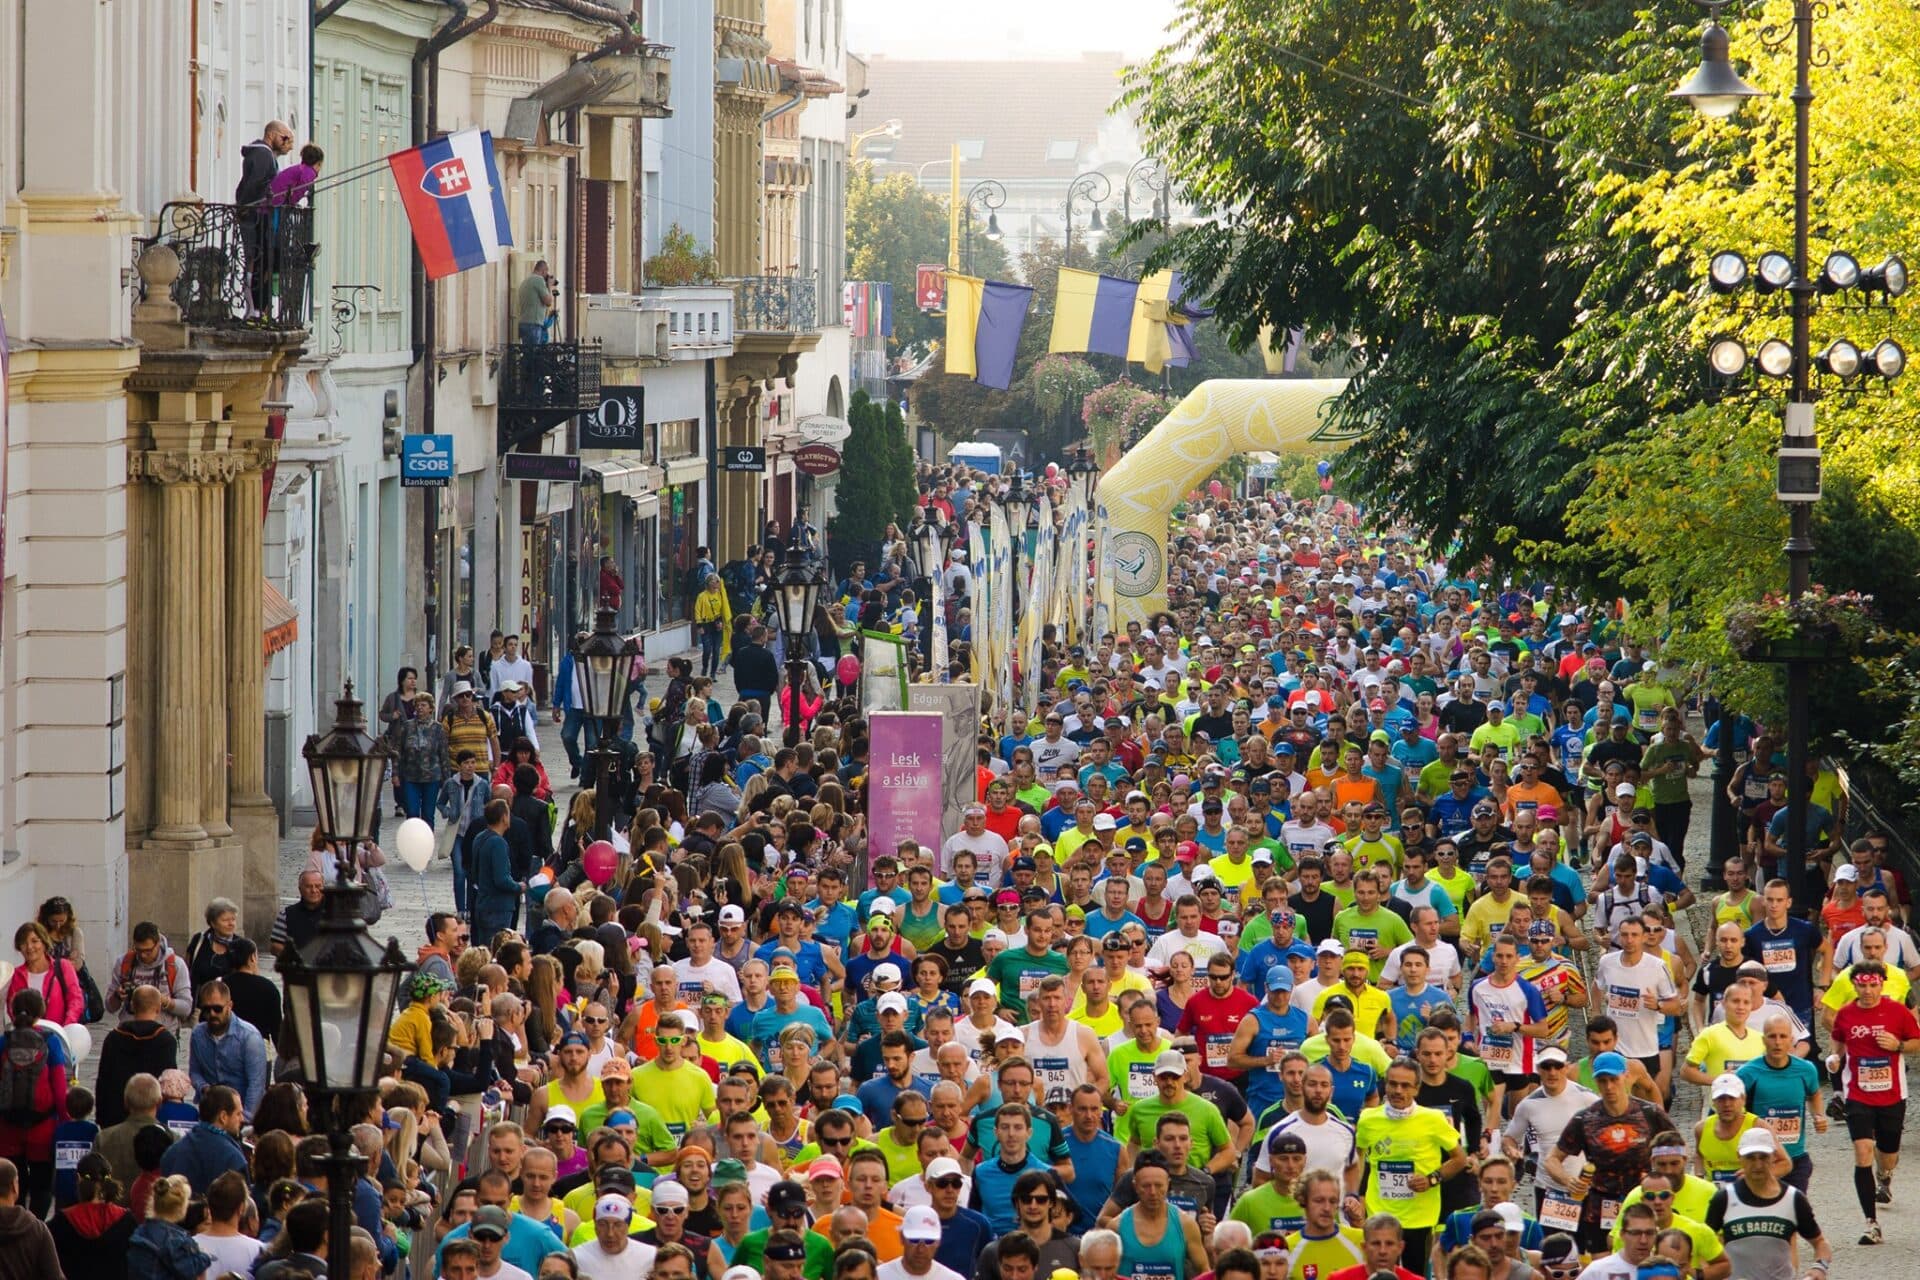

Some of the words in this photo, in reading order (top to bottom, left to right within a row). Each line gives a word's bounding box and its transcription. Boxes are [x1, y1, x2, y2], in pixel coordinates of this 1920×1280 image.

[599, 427, 626, 436] 1939
[409, 457, 448, 471] ČSOB
[404, 478, 445, 486] Bankomat
[521, 531, 530, 661] TABAK
[913, 693, 943, 705] Edgar
[891, 752, 920, 765] Lesk
[883, 777, 890, 785] a
[894, 774, 928, 786] sláva
[1491, 1047, 1511, 1059] 3873
[1048, 1071, 1065, 1082] 845
[1777, 1119, 1799, 1132] 3673
[1554, 1203, 1577, 1218] 3266
[1731, 1223, 1745, 1234] SK
[1746, 1222, 1786, 1235] BABICE
